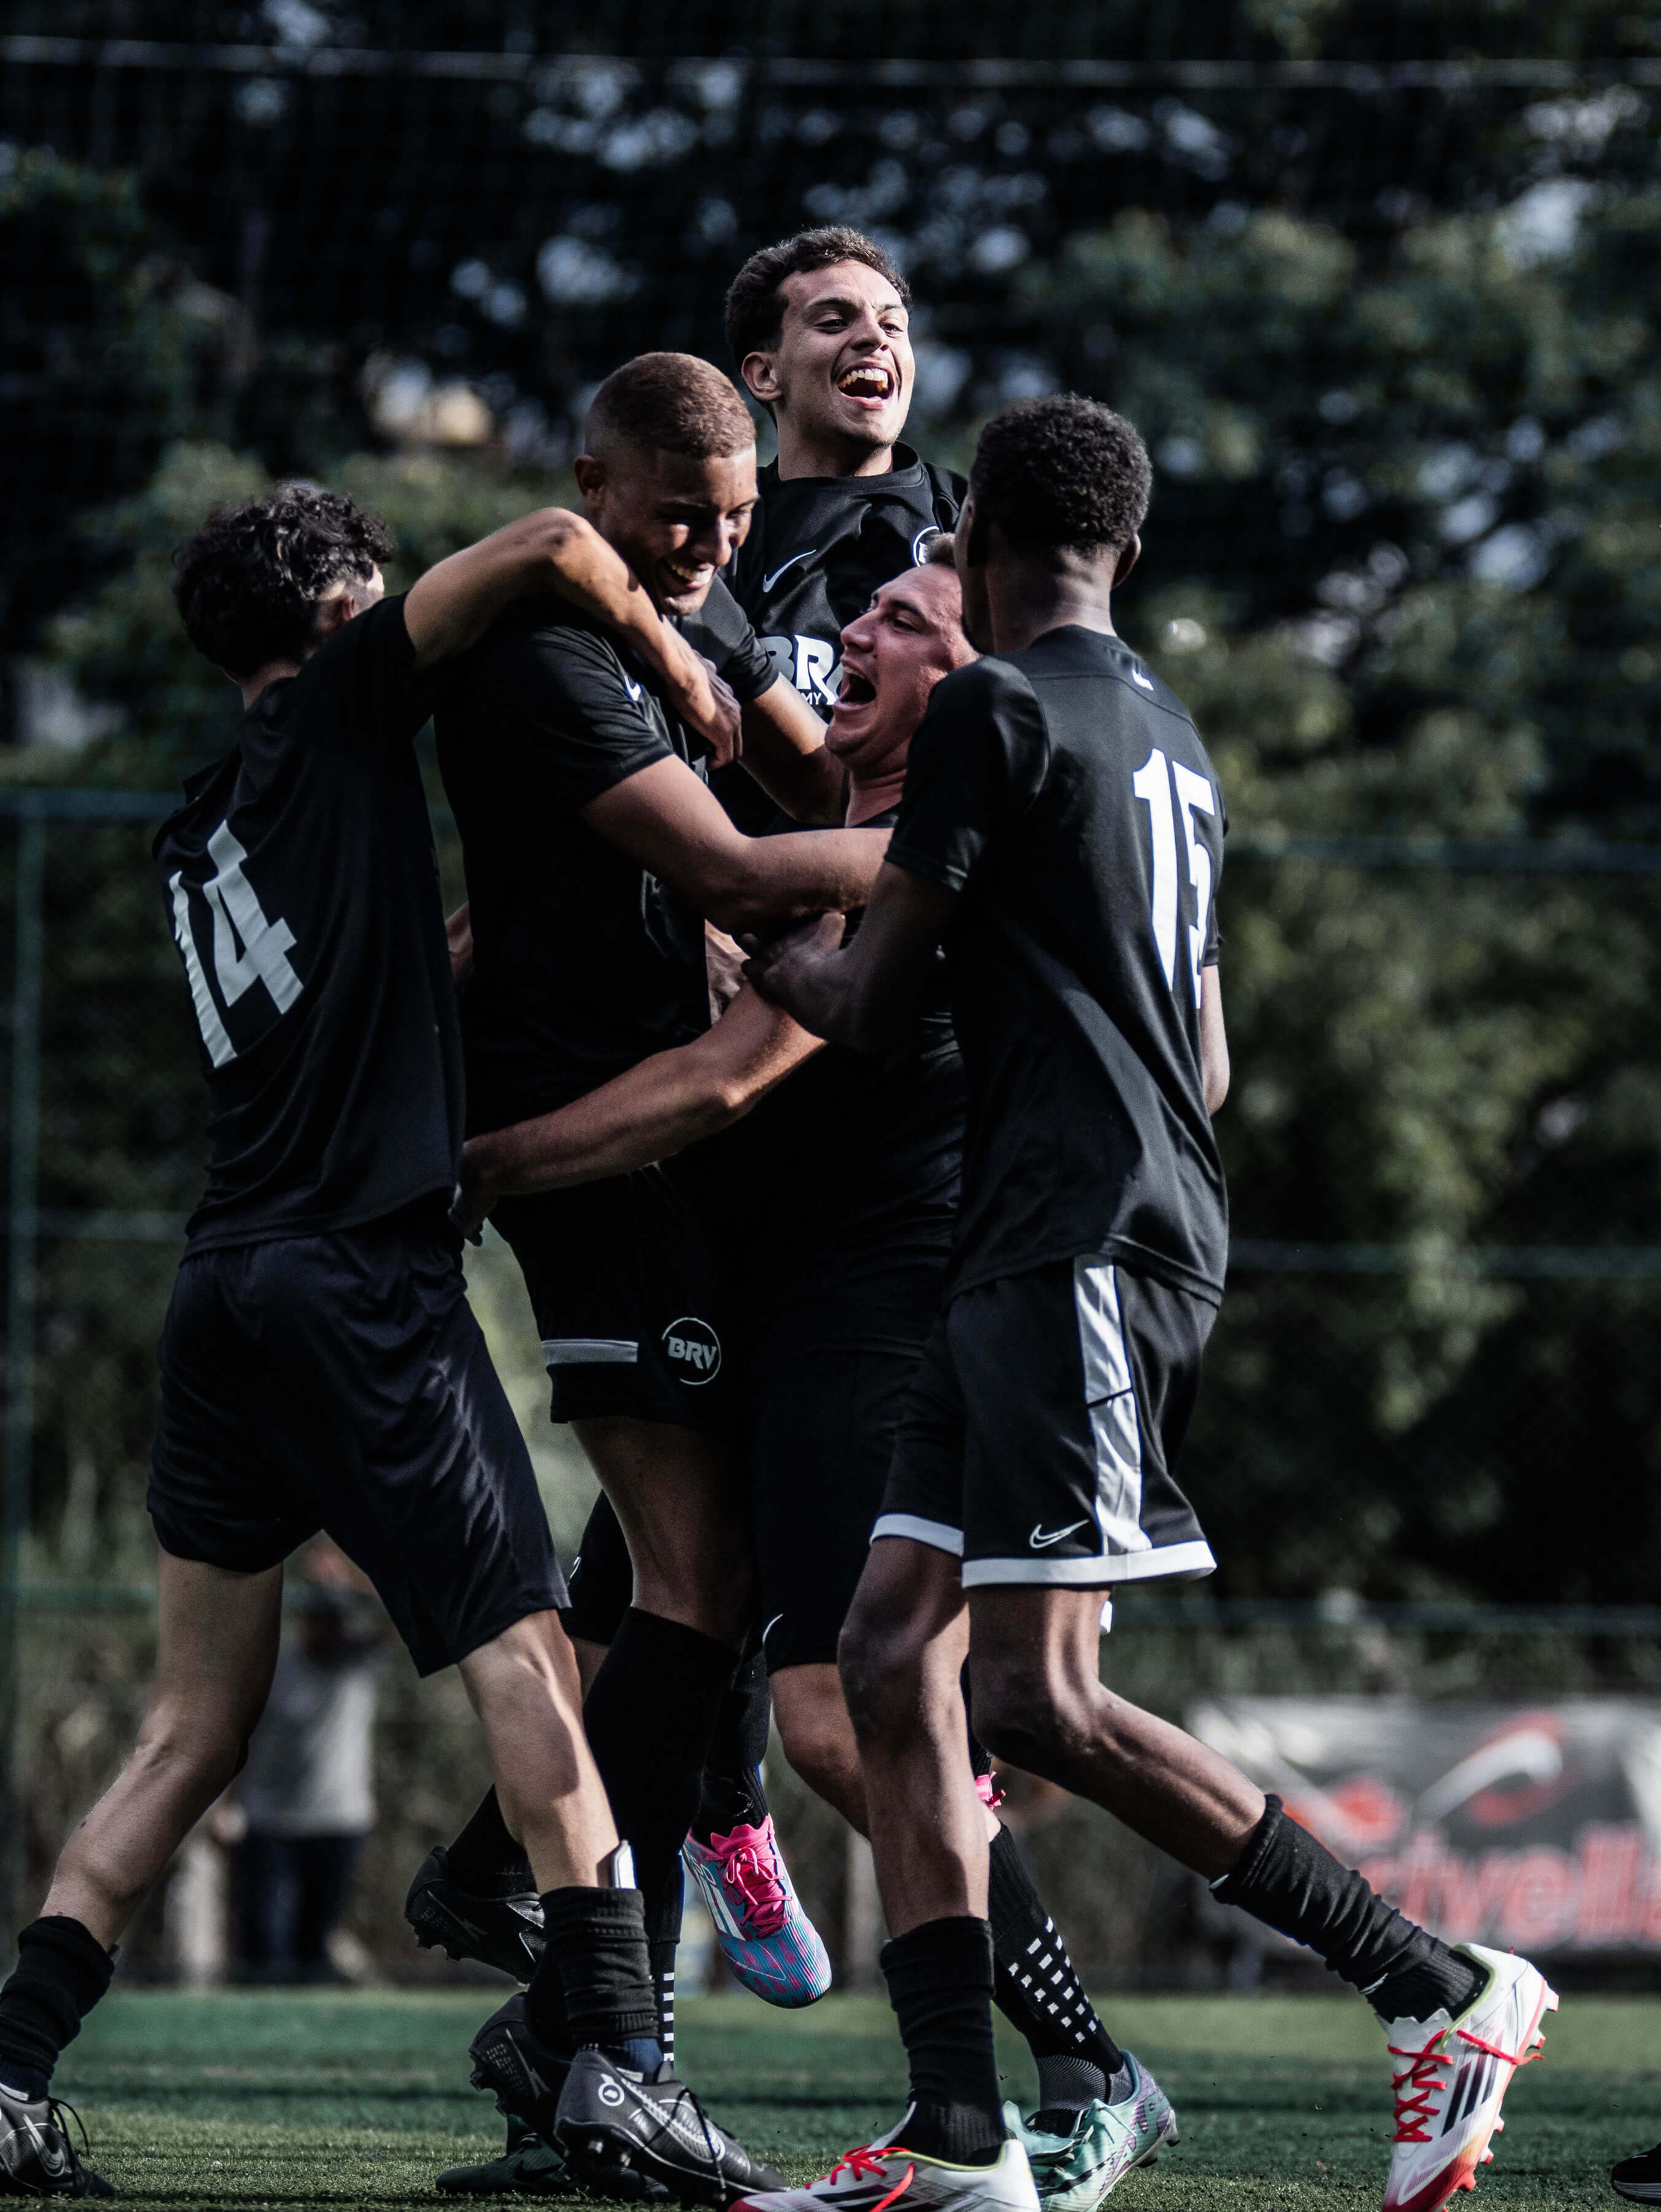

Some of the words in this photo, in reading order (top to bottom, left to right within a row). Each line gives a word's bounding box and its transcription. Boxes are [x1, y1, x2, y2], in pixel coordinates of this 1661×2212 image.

[758, 635, 843, 705] BR
[170, 819, 304, 1068] 14
[1133, 748, 1215, 1009] 15
[669, 1337, 717, 1370] BRV
